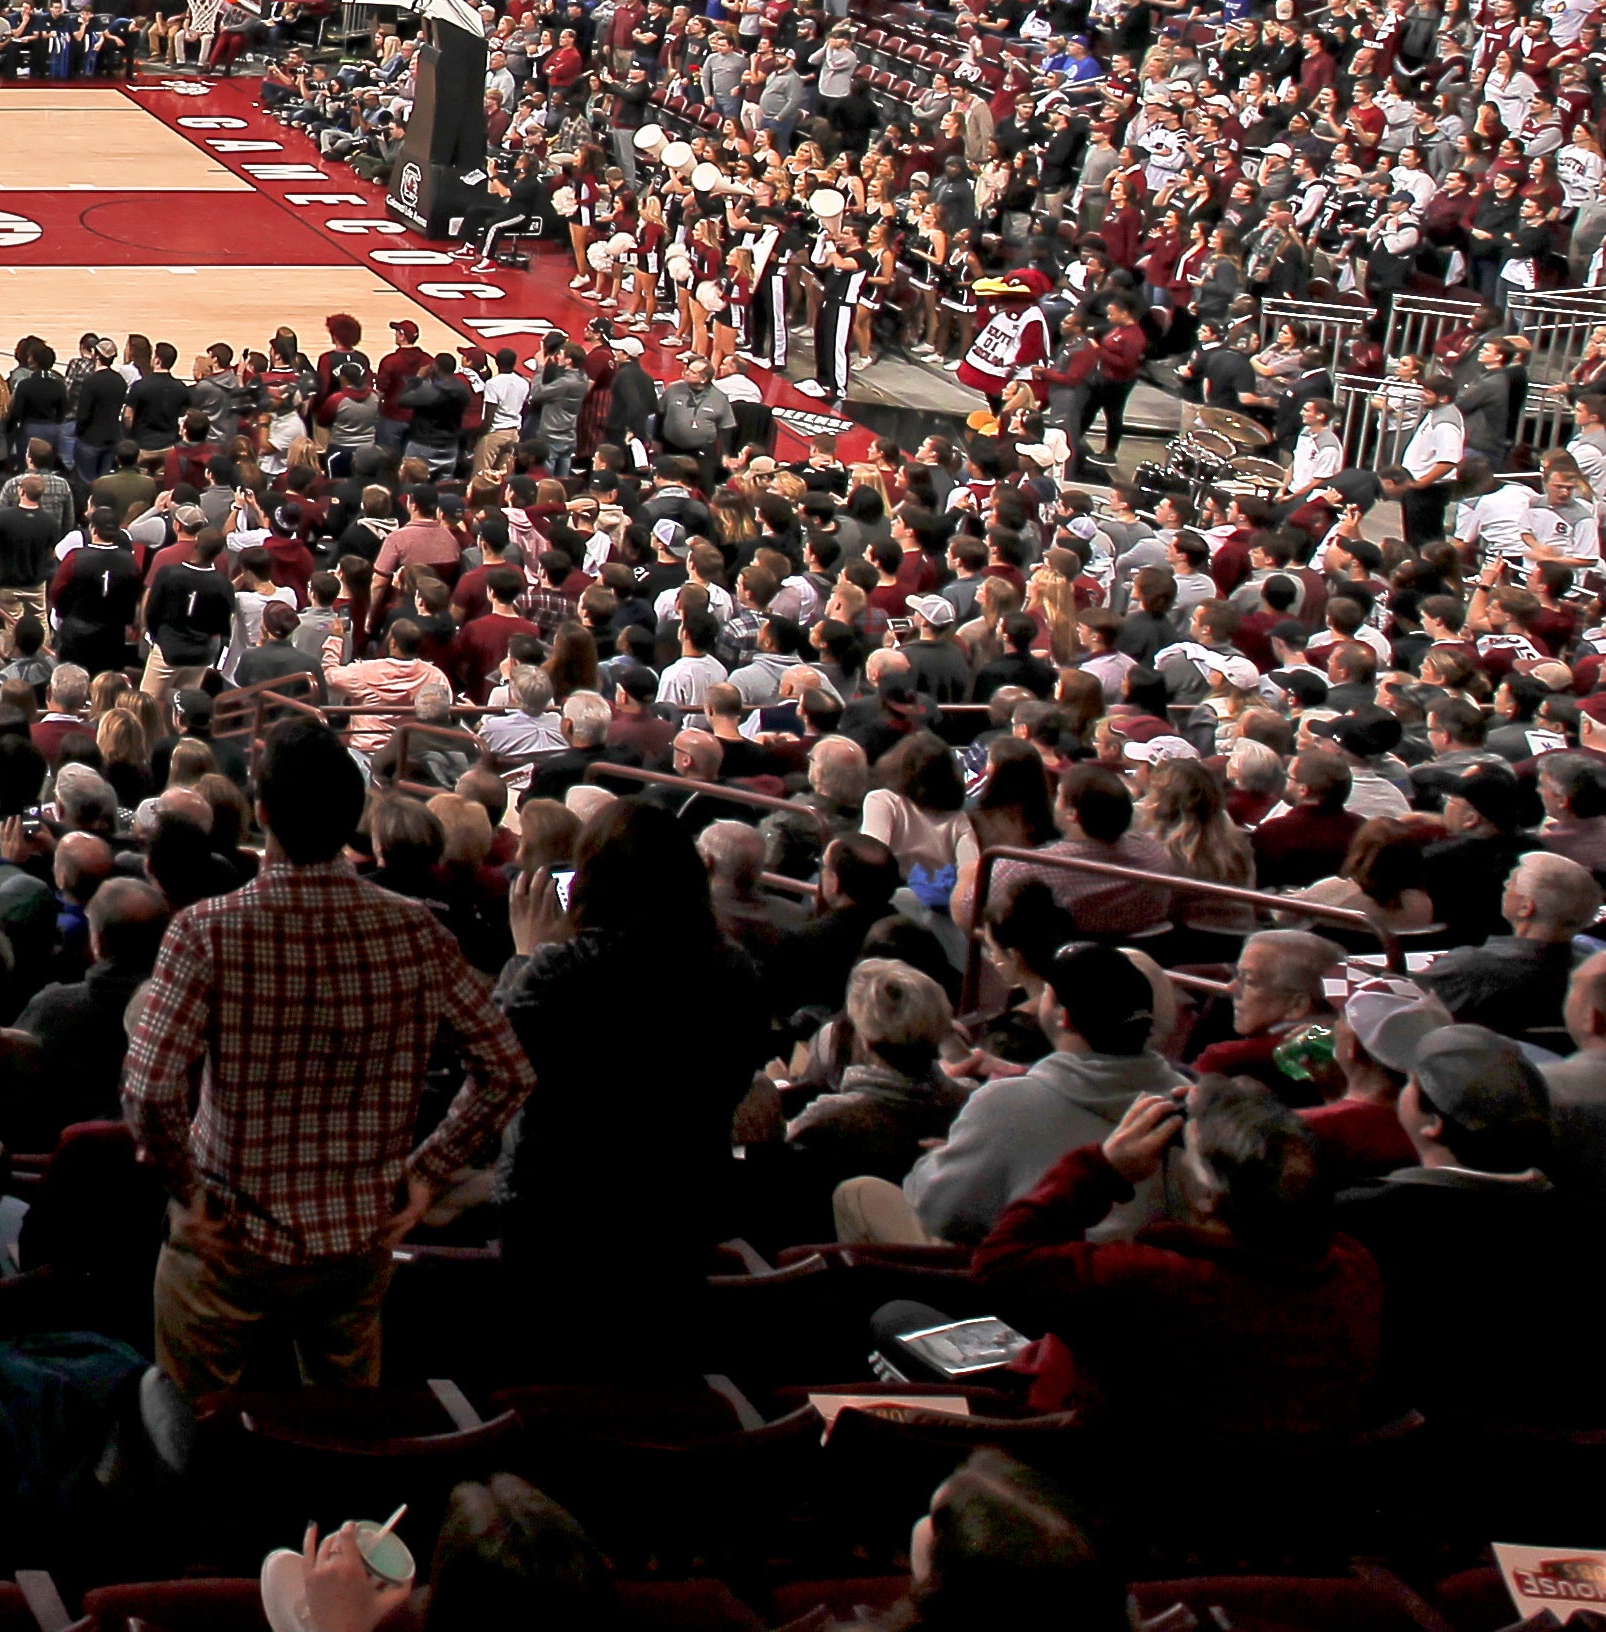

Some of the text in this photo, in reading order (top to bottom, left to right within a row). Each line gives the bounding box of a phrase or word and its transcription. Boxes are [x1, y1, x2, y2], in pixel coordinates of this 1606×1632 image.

[176, 115, 570, 368] GAMECOCK
[771, 406, 853, 432] DEFENSE
[102, 570, 109, 598] 1
[188, 590, 197, 617] 1
